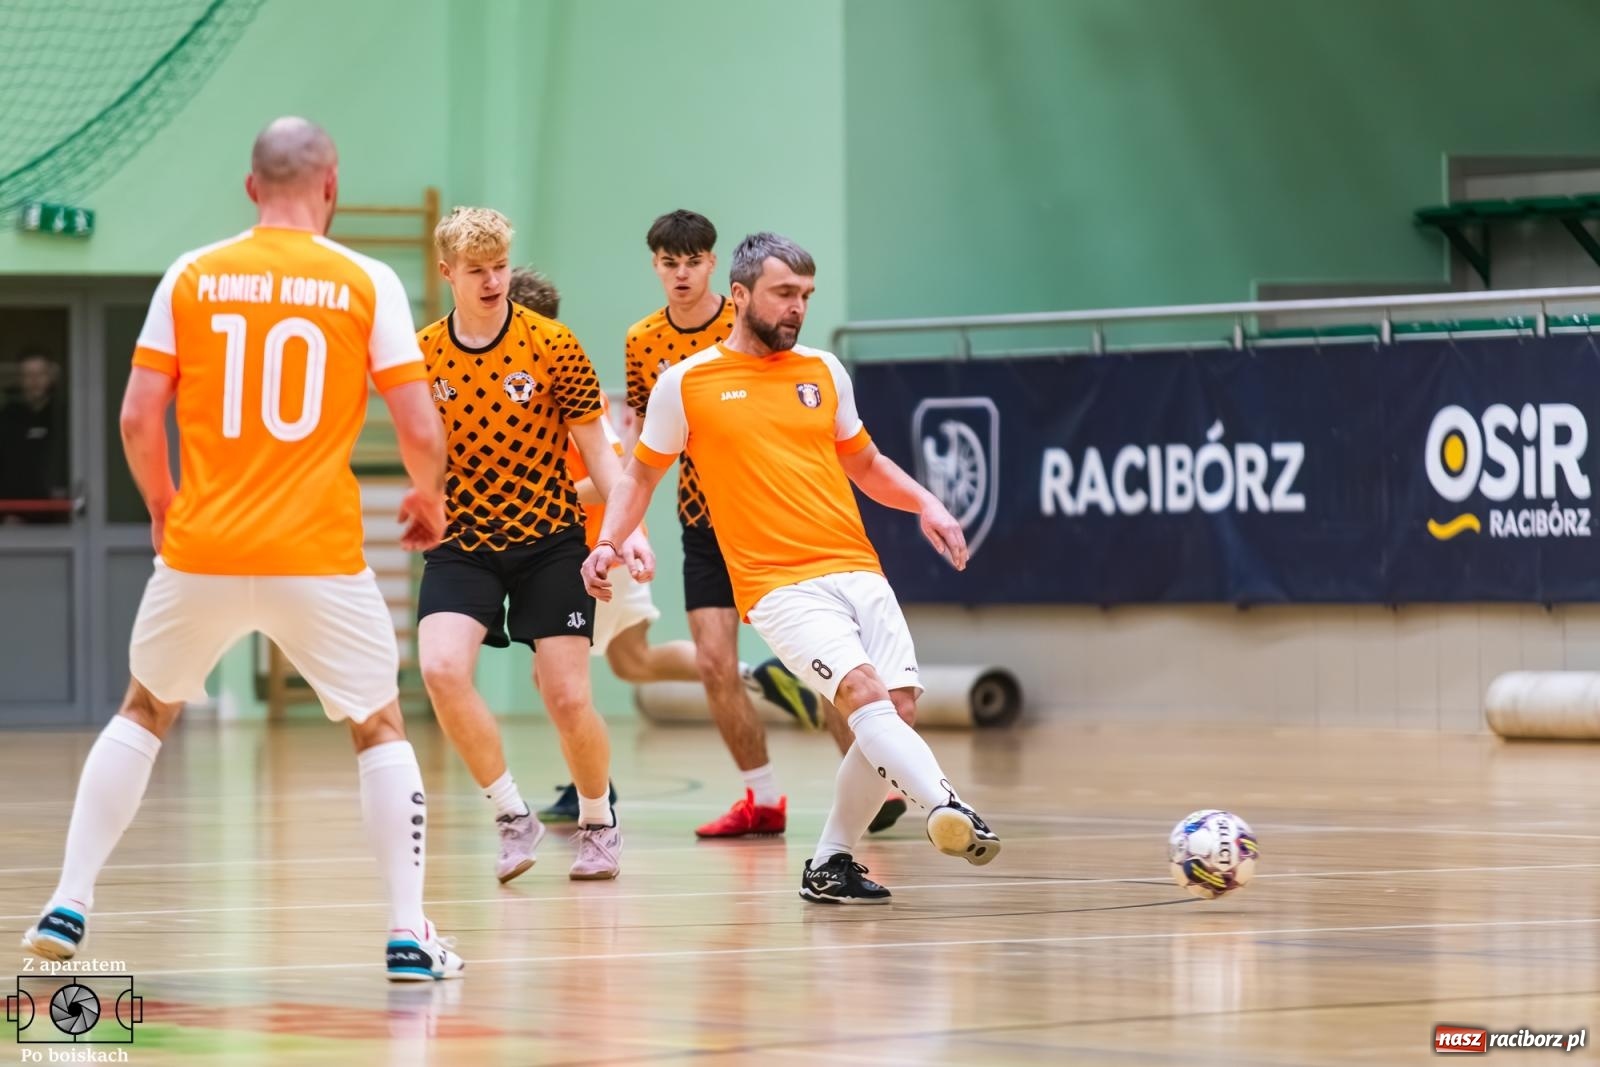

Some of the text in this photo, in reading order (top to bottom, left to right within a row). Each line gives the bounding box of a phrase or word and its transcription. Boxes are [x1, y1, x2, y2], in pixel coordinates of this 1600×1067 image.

[198, 271, 350, 311] PŁOMIEŃ KOBYLA
[211, 313, 327, 442] 10
[721, 389, 748, 401] JAKO
[1040, 418, 1306, 516] RACIBÓRZ
[1425, 402, 1591, 502] OSiR
[1489, 500, 1591, 537] RACIBÓRZ
[811, 659, 833, 680] 8
